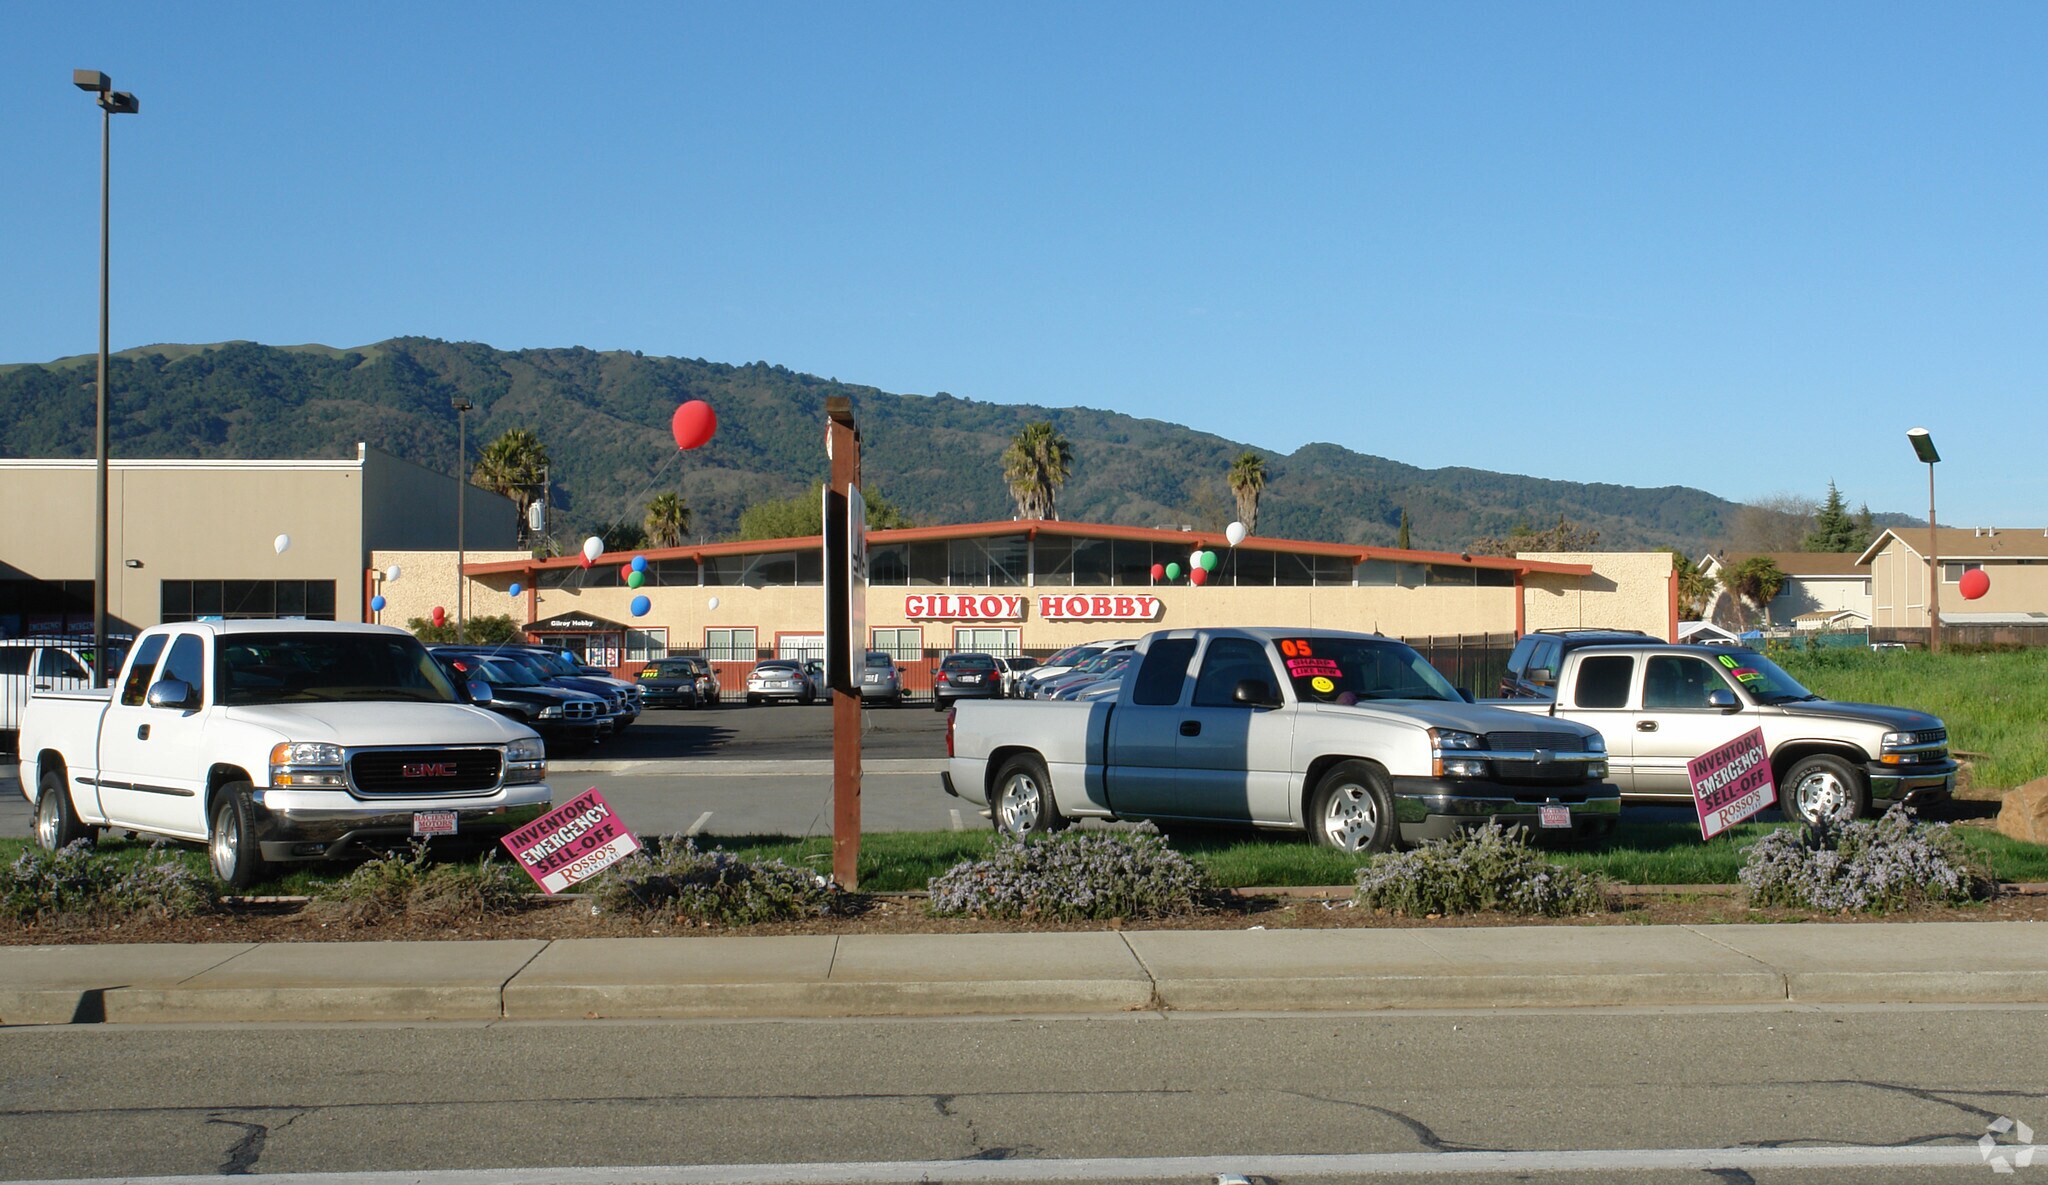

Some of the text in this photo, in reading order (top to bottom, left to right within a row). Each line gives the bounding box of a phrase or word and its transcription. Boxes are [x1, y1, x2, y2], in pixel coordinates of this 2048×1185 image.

[905, 596, 1157, 617] GILROY HOBBY
[551, 620, 593, 628] Gilroy Hobby
[1281, 639, 1312, 657] 05
[1293, 658, 1331, 666] SHARP
[402, 763, 457, 777] GMC
[1693, 732, 1759, 777] INVENTORY
[1696, 745, 1764, 800] EMERGENCY
[1705, 768, 1764, 811] SELL-OFF
[418, 819, 453, 827] MOTORS
[510, 793, 597, 849] INVENTORY
[520, 802, 611, 867] EMERGENCY
[536, 824, 614, 874] SELL-OFF
